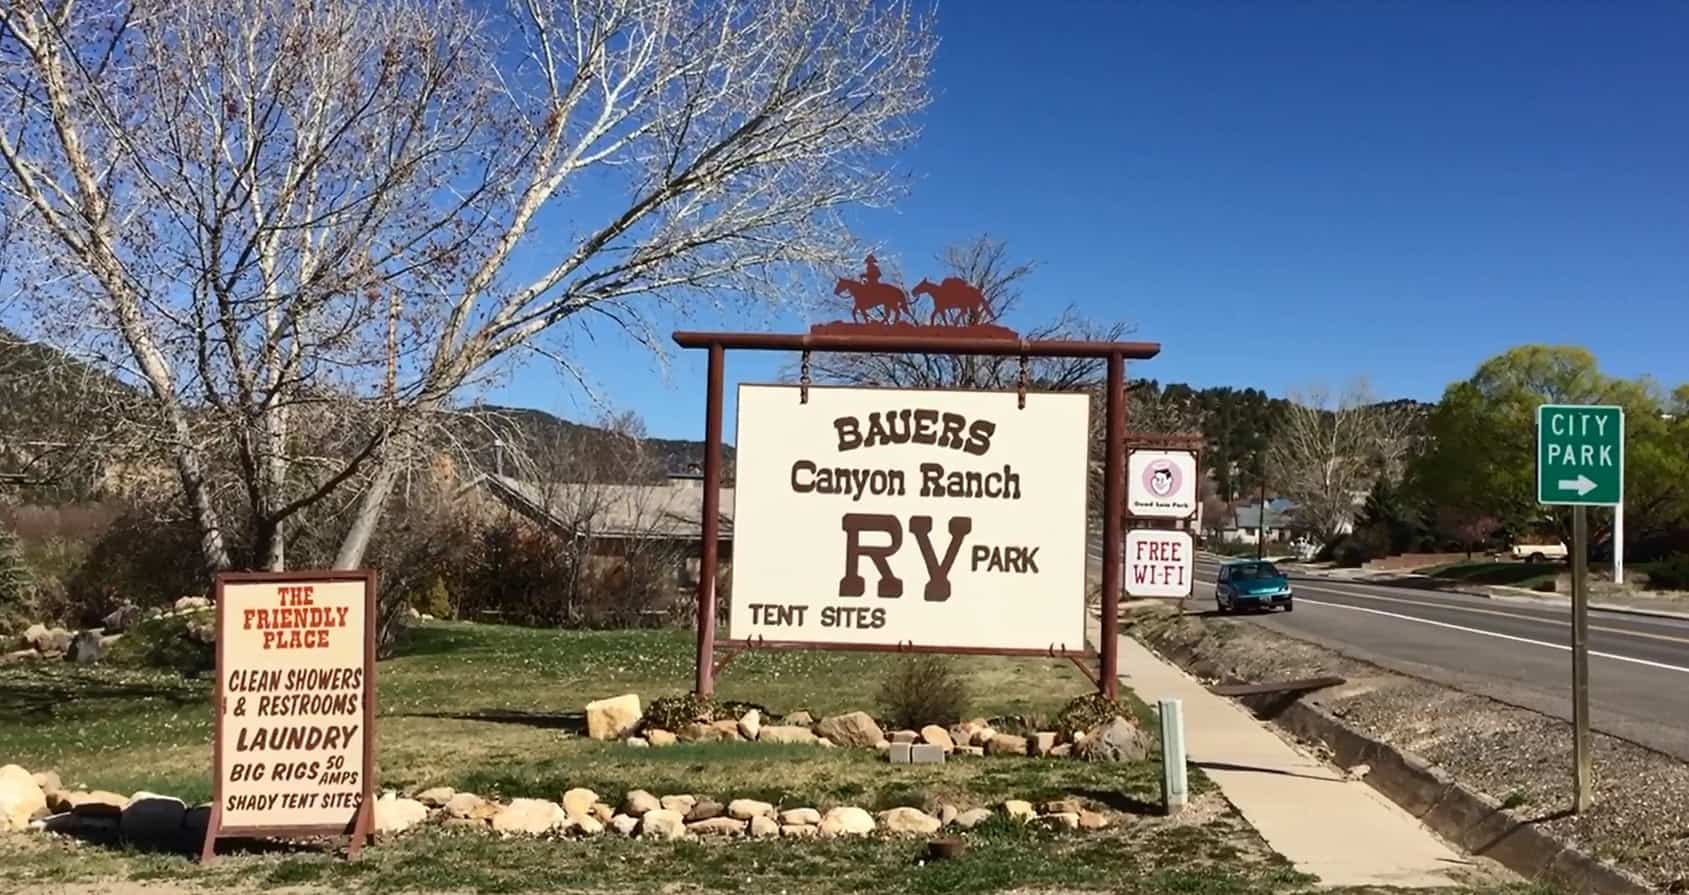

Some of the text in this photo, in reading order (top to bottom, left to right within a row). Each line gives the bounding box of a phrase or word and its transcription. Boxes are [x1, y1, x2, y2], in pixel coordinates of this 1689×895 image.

[834, 408, 996, 456] BAUERS
[1551, 413, 1608, 437] CITY
[1548, 443, 1613, 467] PARK
[791, 460, 1021, 501] Canyon Ranch
[839, 513, 1040, 602] RV PARK
[1136, 541, 1181, 562] FREE
[1133, 565, 1184, 586] WI-FI
[277, 586, 314, 606] THE
[243, 606, 349, 630] FRIENDLY
[748, 604, 886, 628] TENT SITES
[263, 630, 330, 649] PLACE
[228, 667, 362, 692] CLEAN SHOWERS
[233, 693, 357, 716] & RESTROOMS
[236, 725, 359, 751] LAUNDRY
[229, 761, 320, 782] BIG RIGS
[326, 755, 344, 770] 50
[319, 771, 358, 785] AMPS
[226, 792, 362, 811] SHADY TENT SITES
